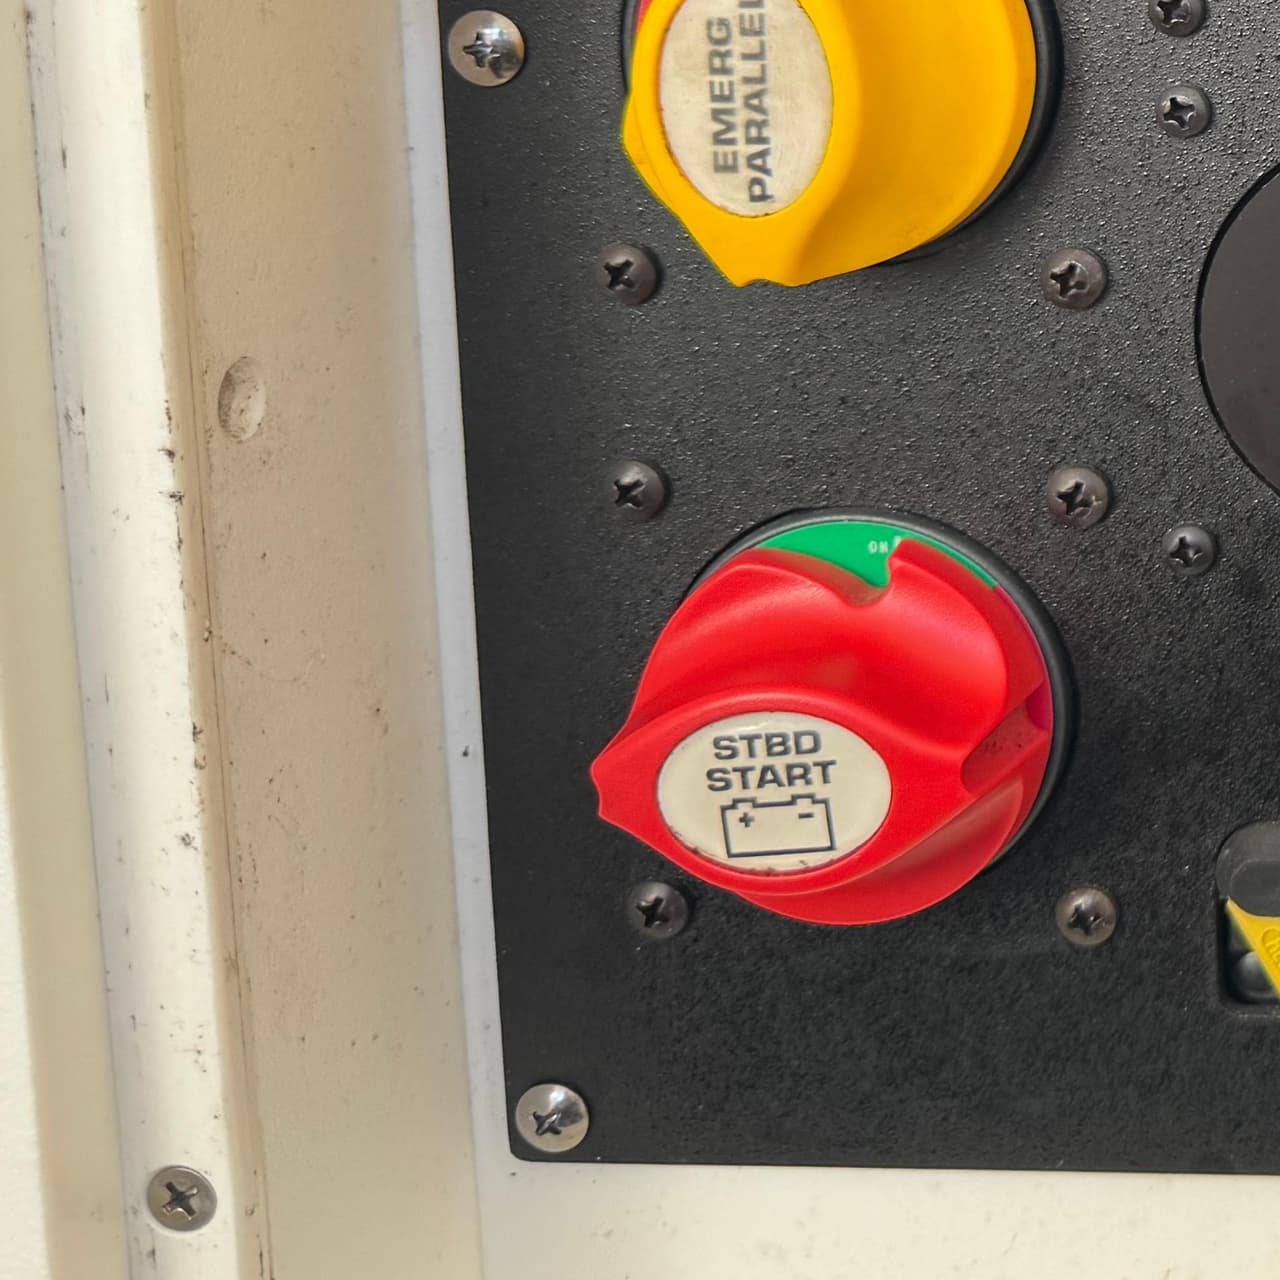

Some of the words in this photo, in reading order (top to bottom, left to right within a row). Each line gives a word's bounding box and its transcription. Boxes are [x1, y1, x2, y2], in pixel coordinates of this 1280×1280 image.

[706, 17, 739, 174] EMERG
[712, 729, 823, 761] STBD
[705, 758, 837, 792] START
